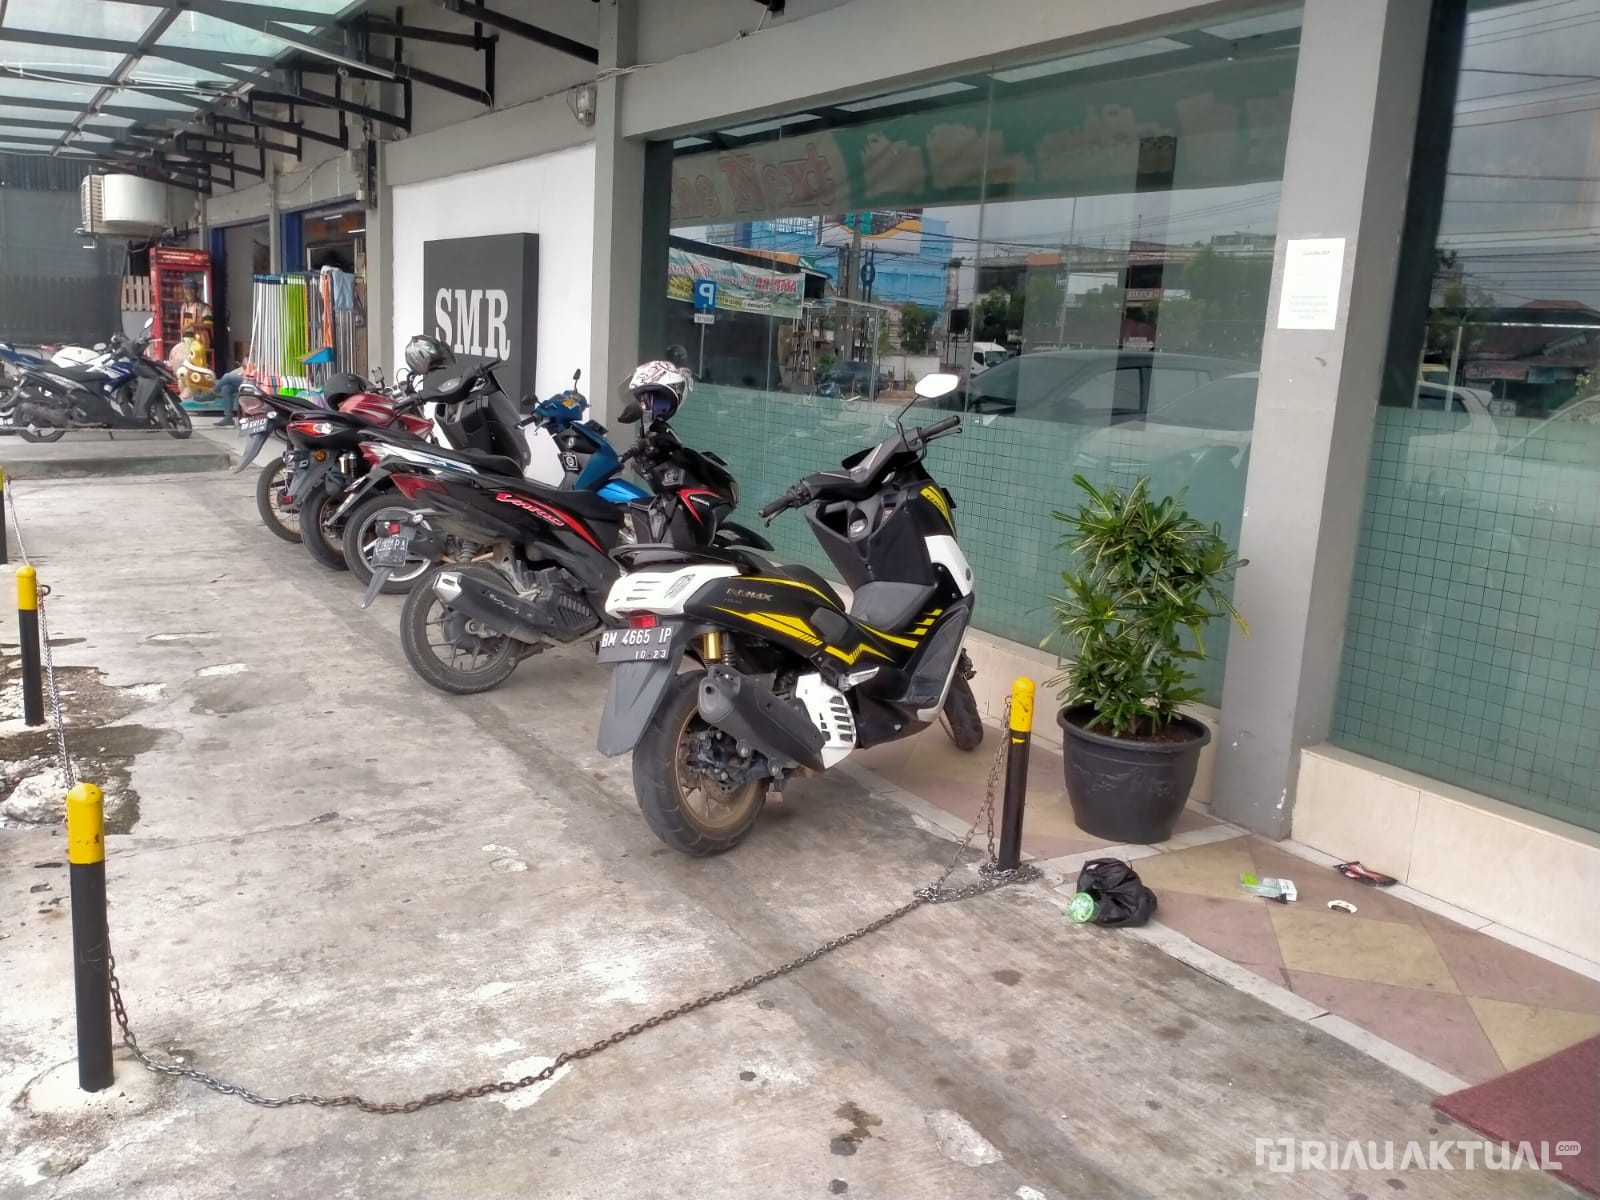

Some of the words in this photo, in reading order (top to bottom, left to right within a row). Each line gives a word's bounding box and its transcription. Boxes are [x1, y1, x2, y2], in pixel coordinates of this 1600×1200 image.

[435, 288, 511, 361] SMR
[601, 631, 617, 648] BM
[621, 629, 651, 645] 4665
[658, 627, 672, 643] IP
